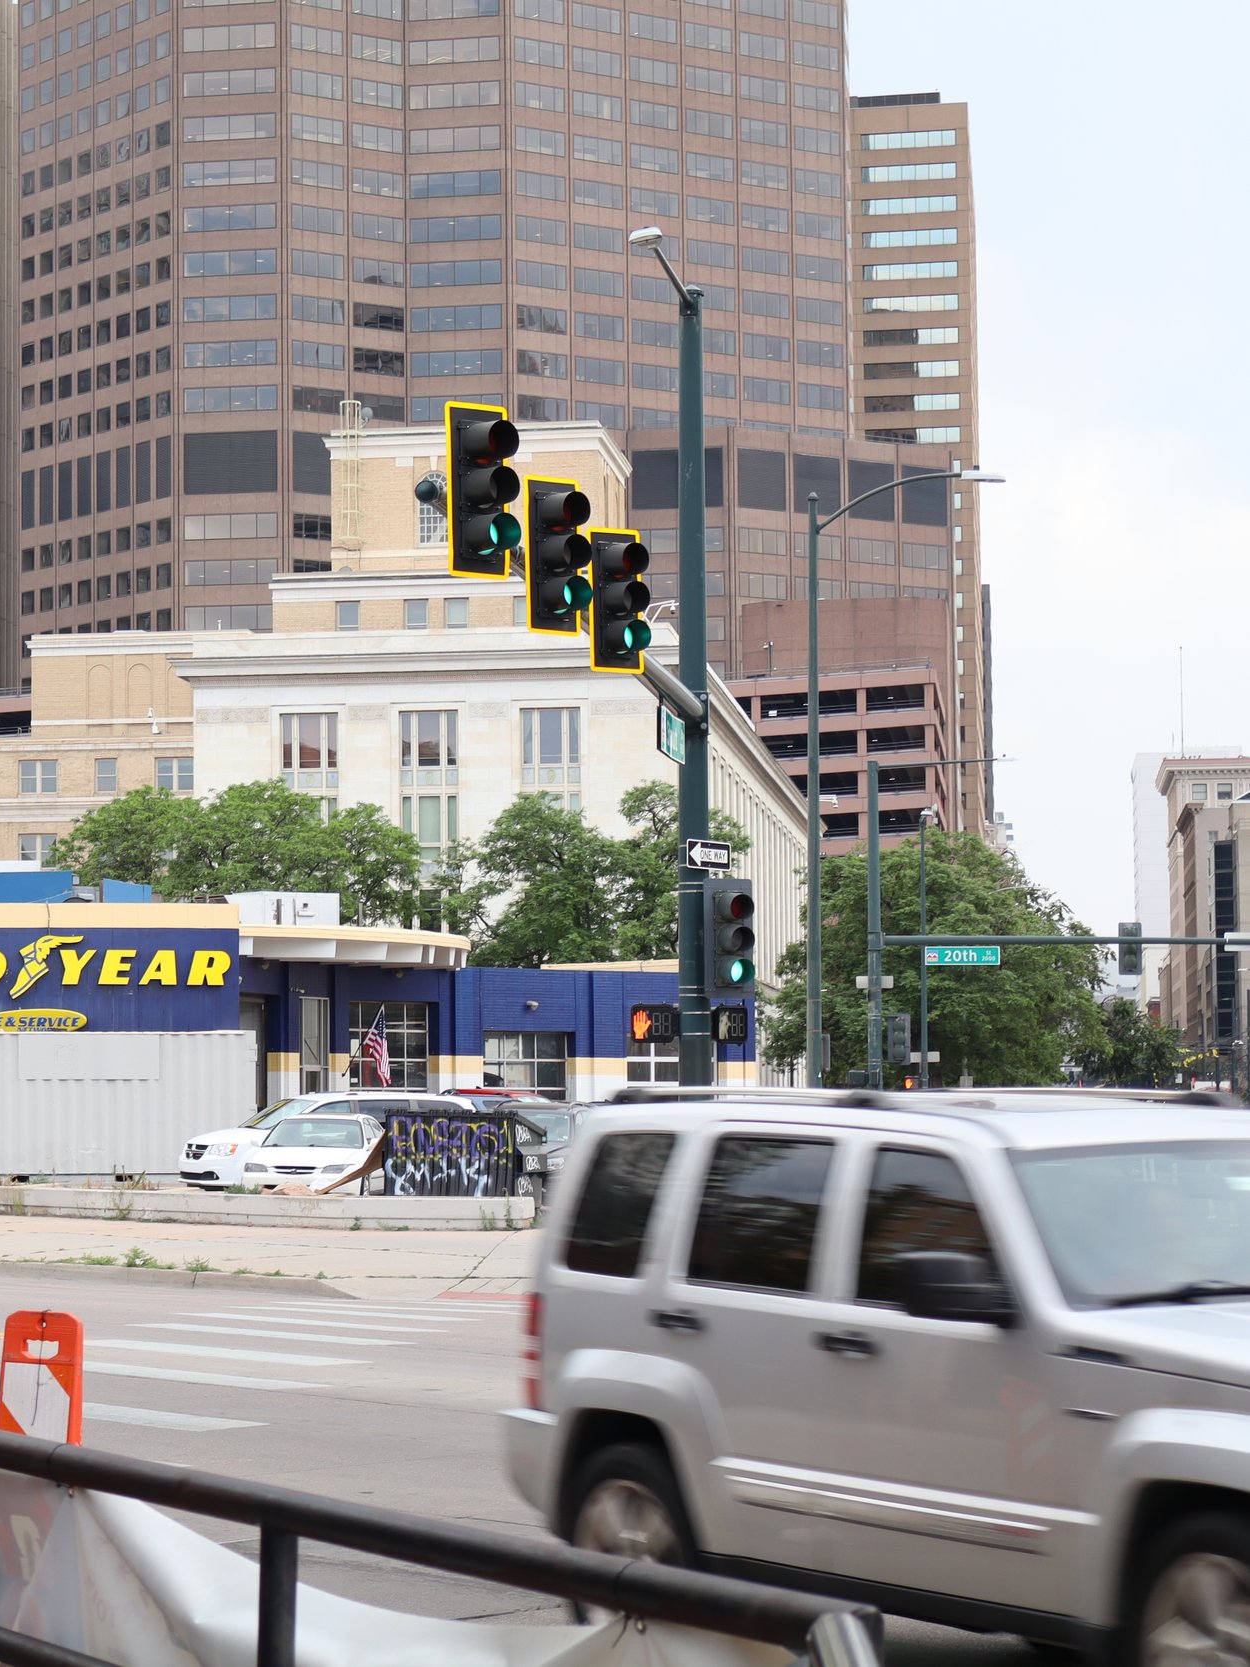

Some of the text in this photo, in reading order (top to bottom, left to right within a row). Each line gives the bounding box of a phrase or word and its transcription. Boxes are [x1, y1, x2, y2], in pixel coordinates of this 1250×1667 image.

[701, 849, 726, 862] ONE WAY
[944, 950, 977, 962] 20th
[4, 1016, 16, 1027] &
[18, 1016, 80, 1027] SERVICE
